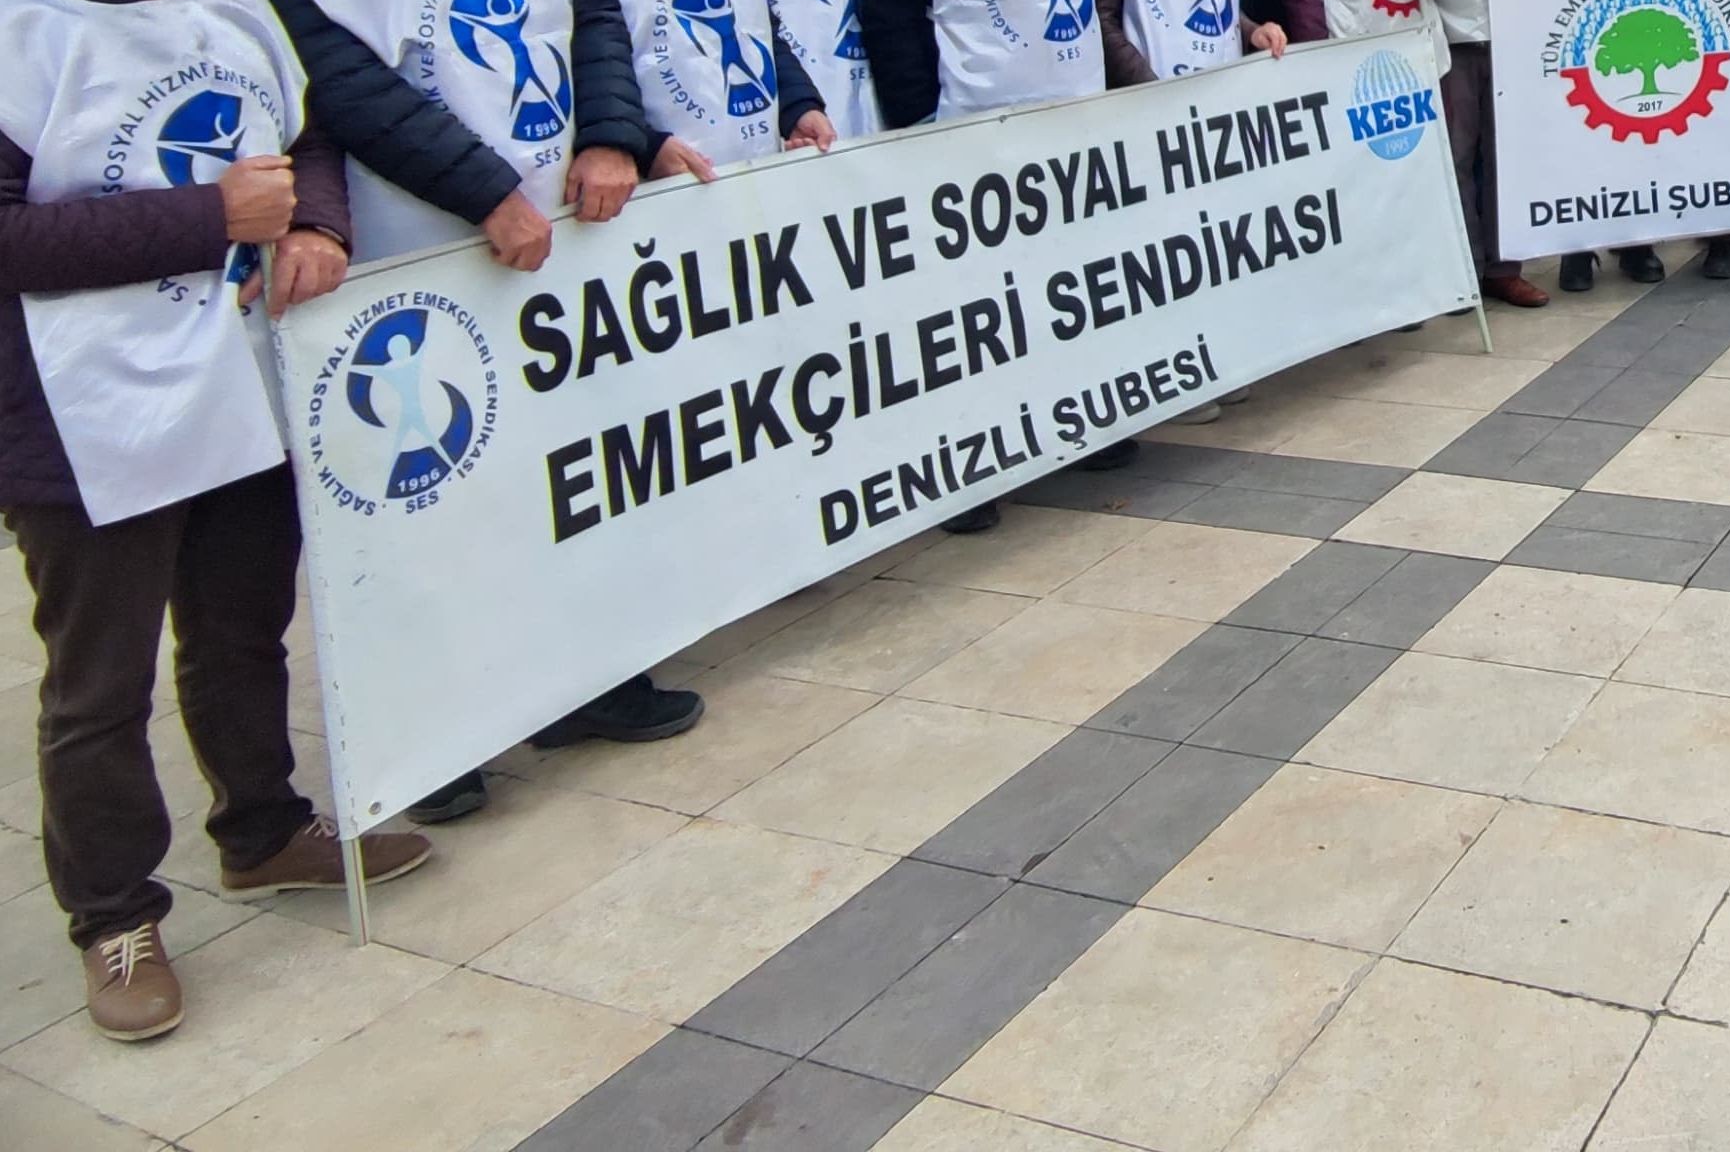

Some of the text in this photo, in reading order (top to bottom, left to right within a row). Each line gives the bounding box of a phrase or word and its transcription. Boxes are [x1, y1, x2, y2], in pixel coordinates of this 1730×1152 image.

[1056, 47, 1081, 62] SES
[1192, 40, 1215, 54] SES
[1540, 32, 1564, 77] TÜM
[850, 67, 867, 80] SE
[1346, 88, 1437, 142] KESK
[1637, 100, 1663, 113] 2017
[740, 121, 769, 140] SES
[534, 146, 562, 169] SES
[1530, 181, 1658, 227] DENİZLİ
[518, 90, 1331, 393] SAĞLIK VE SOSYAL HİZMET
[545, 188, 1343, 545] EMEKÇİLERİ SENDİKASI
[308, 291, 499, 517] SAĞLIK VE SOSYAL HİZMET EMEKÇİLERİ SENDİKASI
[819, 334, 1219, 547] DENİZLİ ŞUBESİ
[398, 467, 441, 493] 1996
[405, 490, 440, 515] SES
